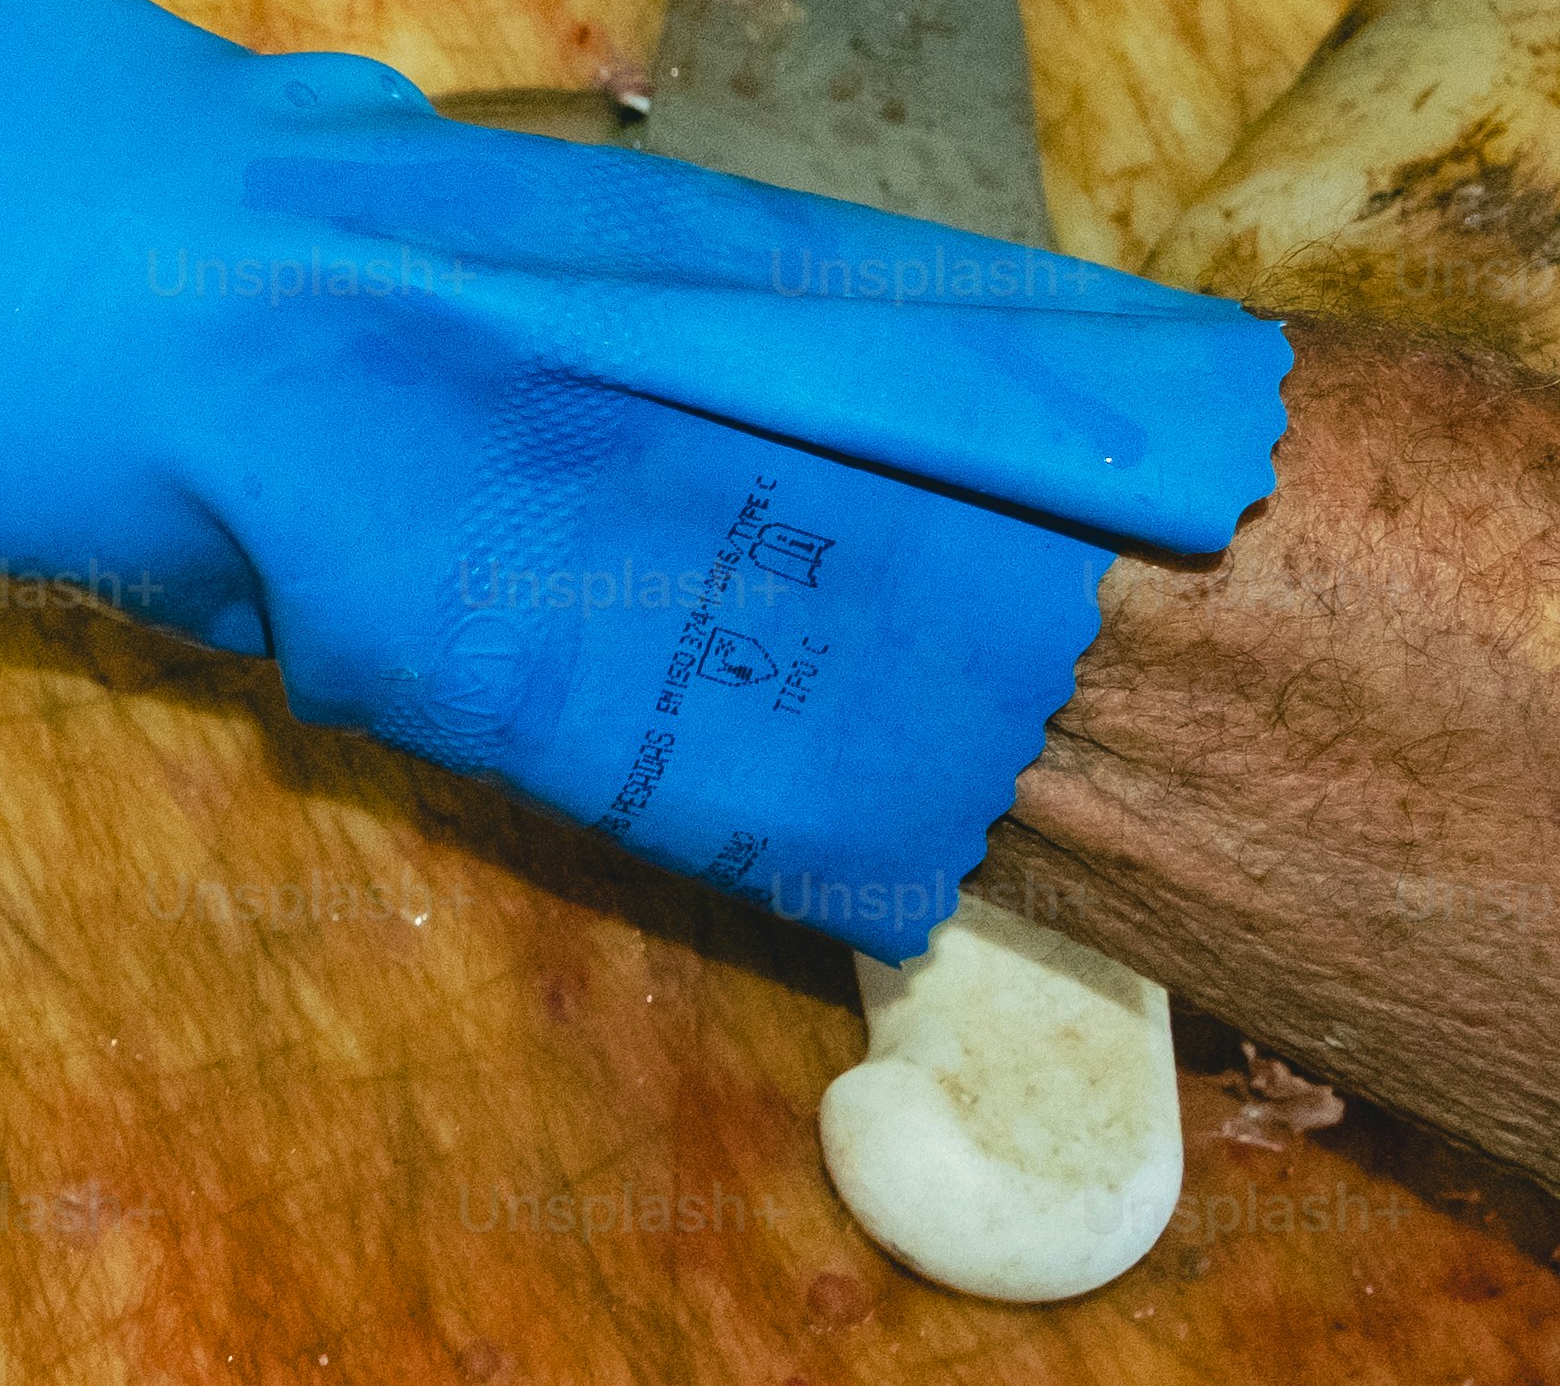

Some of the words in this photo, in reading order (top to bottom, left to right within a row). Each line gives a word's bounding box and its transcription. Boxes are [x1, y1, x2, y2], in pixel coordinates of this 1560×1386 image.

[664, 650, 697, 689] ISO
[755, 474, 778, 492] C
[771, 660, 819, 716] TIPO
[800, 634, 831, 656] C
